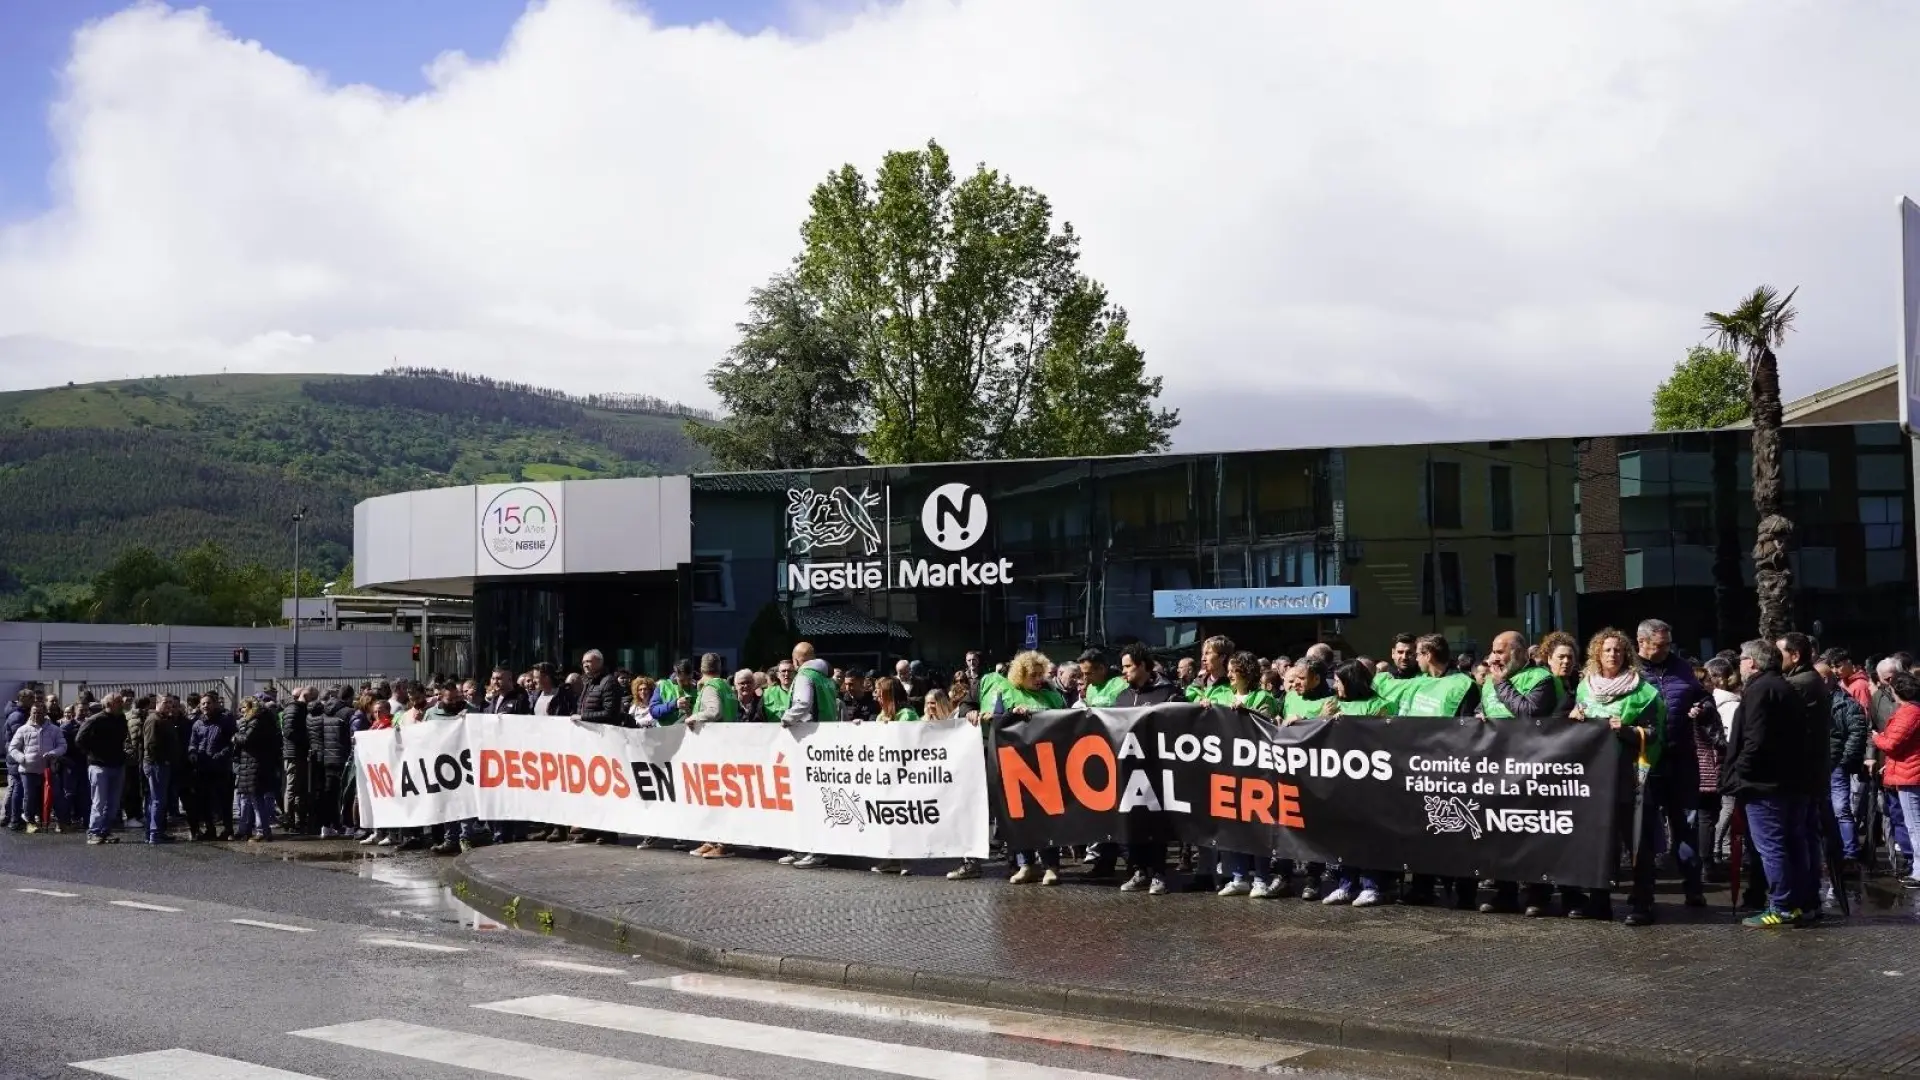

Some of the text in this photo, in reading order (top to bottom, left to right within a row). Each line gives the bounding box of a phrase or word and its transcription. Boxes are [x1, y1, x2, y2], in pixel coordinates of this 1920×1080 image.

[788, 556, 1013, 591] Nestlé Market
[1255, 595, 1309, 610] Market
[806, 745, 948, 766] Comité de Empresa
[1117, 732, 1393, 781] A LOS DESPIDOS
[1409, 755, 1585, 779] Comité de Empresa
[367, 763, 394, 798] NO
[401, 761, 419, 797] A
[480, 749, 631, 799] DESPIDOS
[630, 761, 676, 802] EN
[681, 752, 794, 811] NESTLÉ
[806, 766, 953, 785] Fábrica de La Penilla
[998, 735, 1117, 819] NO
[1405, 776, 1590, 798] Fábrica de La Penilla
[865, 799, 940, 825] Nestlé
[1118, 769, 1305, 829] AL ERE
[1486, 808, 1574, 835] Nestlé
